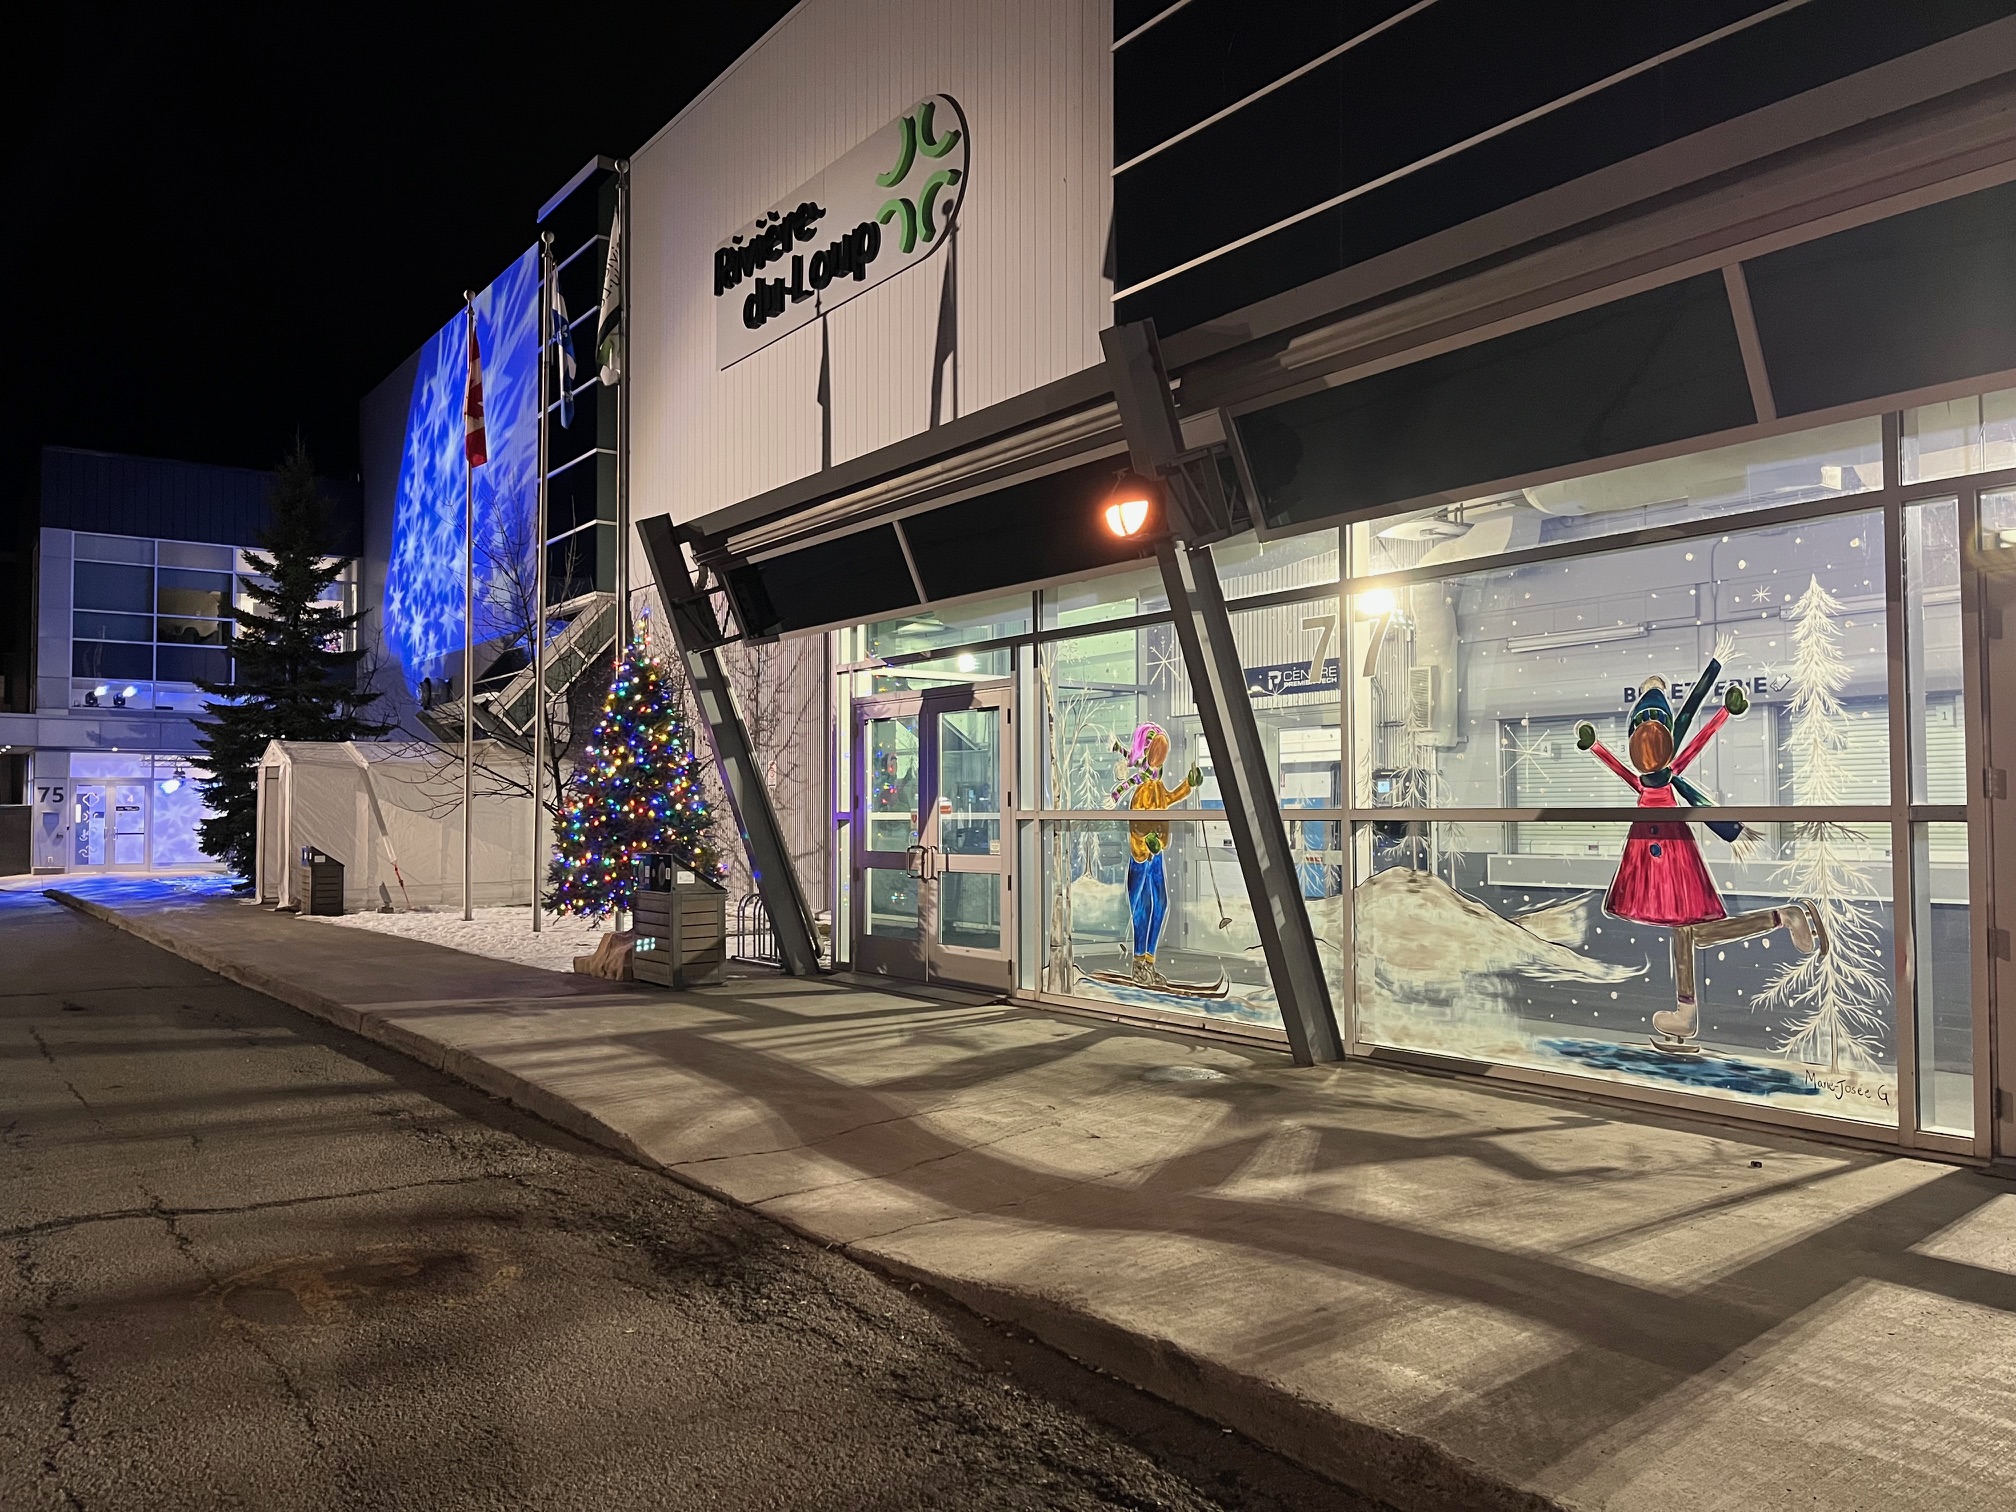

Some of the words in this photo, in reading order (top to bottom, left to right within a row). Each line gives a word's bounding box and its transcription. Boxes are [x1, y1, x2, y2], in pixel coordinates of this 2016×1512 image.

[1302, 610, 1393, 683] 77
[1283, 665, 1337, 682] CENRE
[1620, 744, 1626, 753] 3
[38, 787, 64, 803] 75
[1877, 1084, 1890, 1106] G
